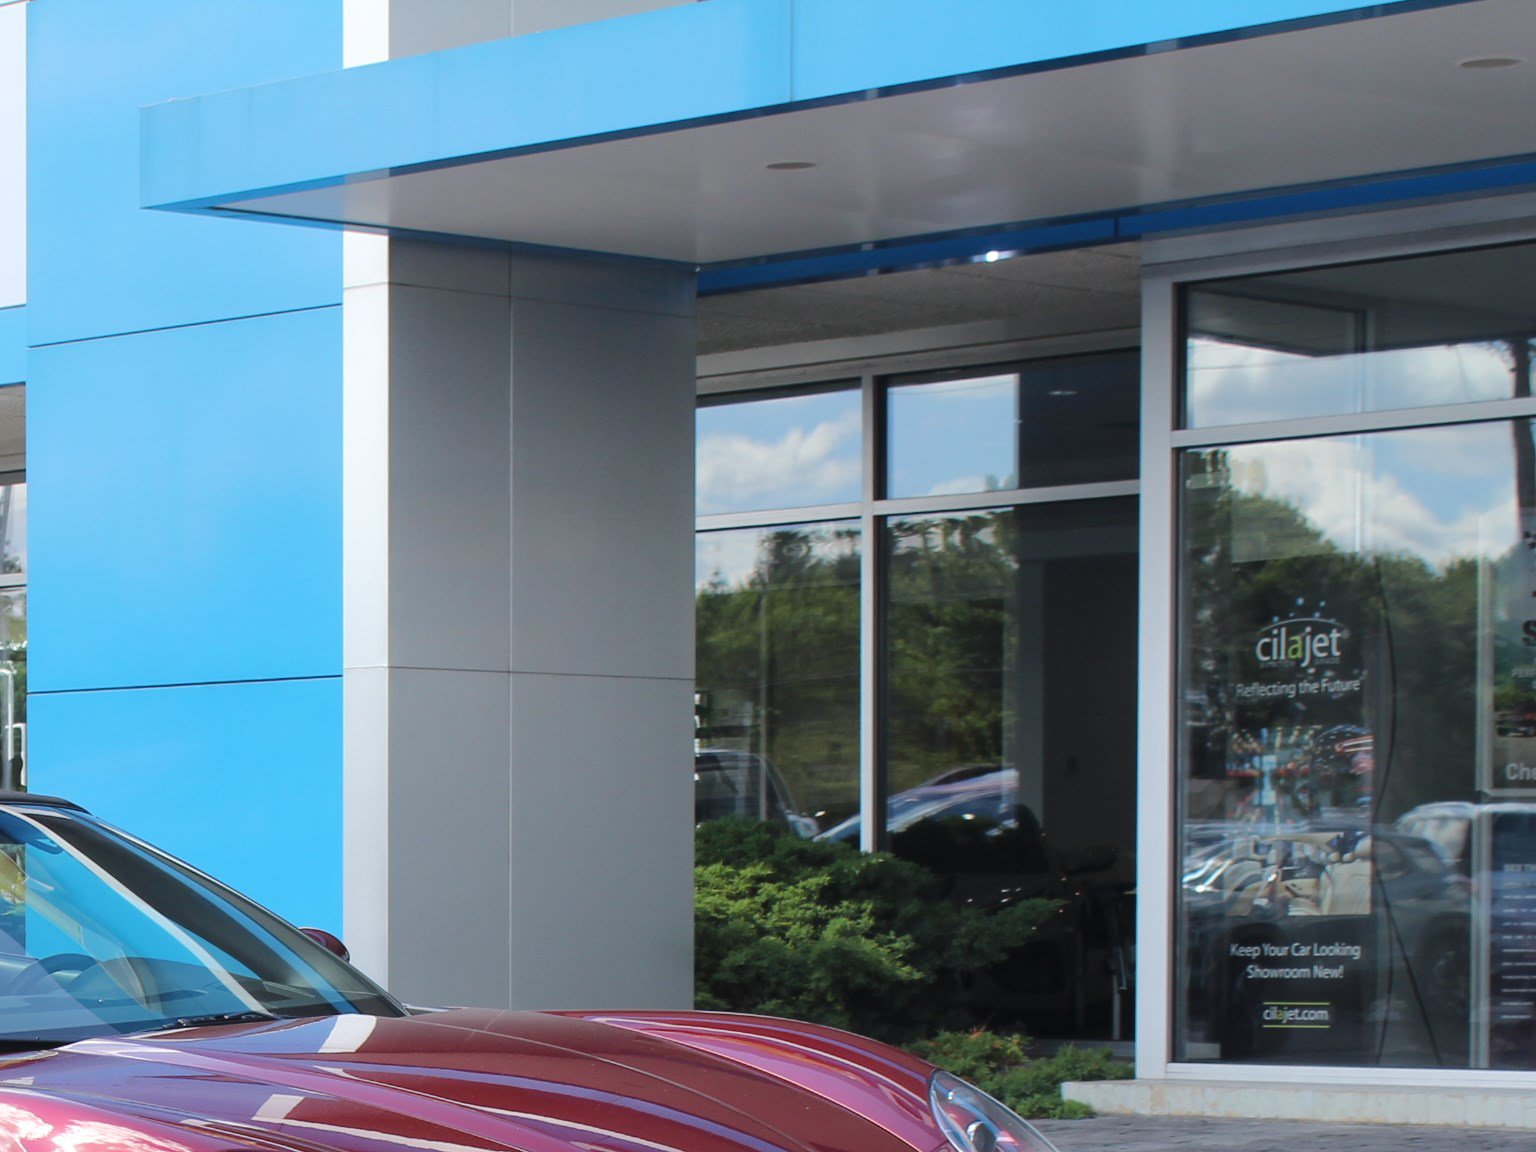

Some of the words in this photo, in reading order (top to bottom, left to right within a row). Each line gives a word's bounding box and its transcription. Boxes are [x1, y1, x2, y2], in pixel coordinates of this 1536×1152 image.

[1254, 626, 1343, 668] cilajet
[1235, 681, 1297, 699] Reflecting
[1298, 680, 1320, 694] the
[1321, 678, 1361, 693] Future
[1229, 943, 1262, 960] Keep
[1262, 943, 1290, 957] Your
[1290, 942, 1312, 957] Car
[1312, 942, 1362, 960] Looking
[1245, 965, 1311, 979] Showroom
[1312, 965, 1344, 979] New!
[1262, 1006, 1330, 1024] cilajet.com
